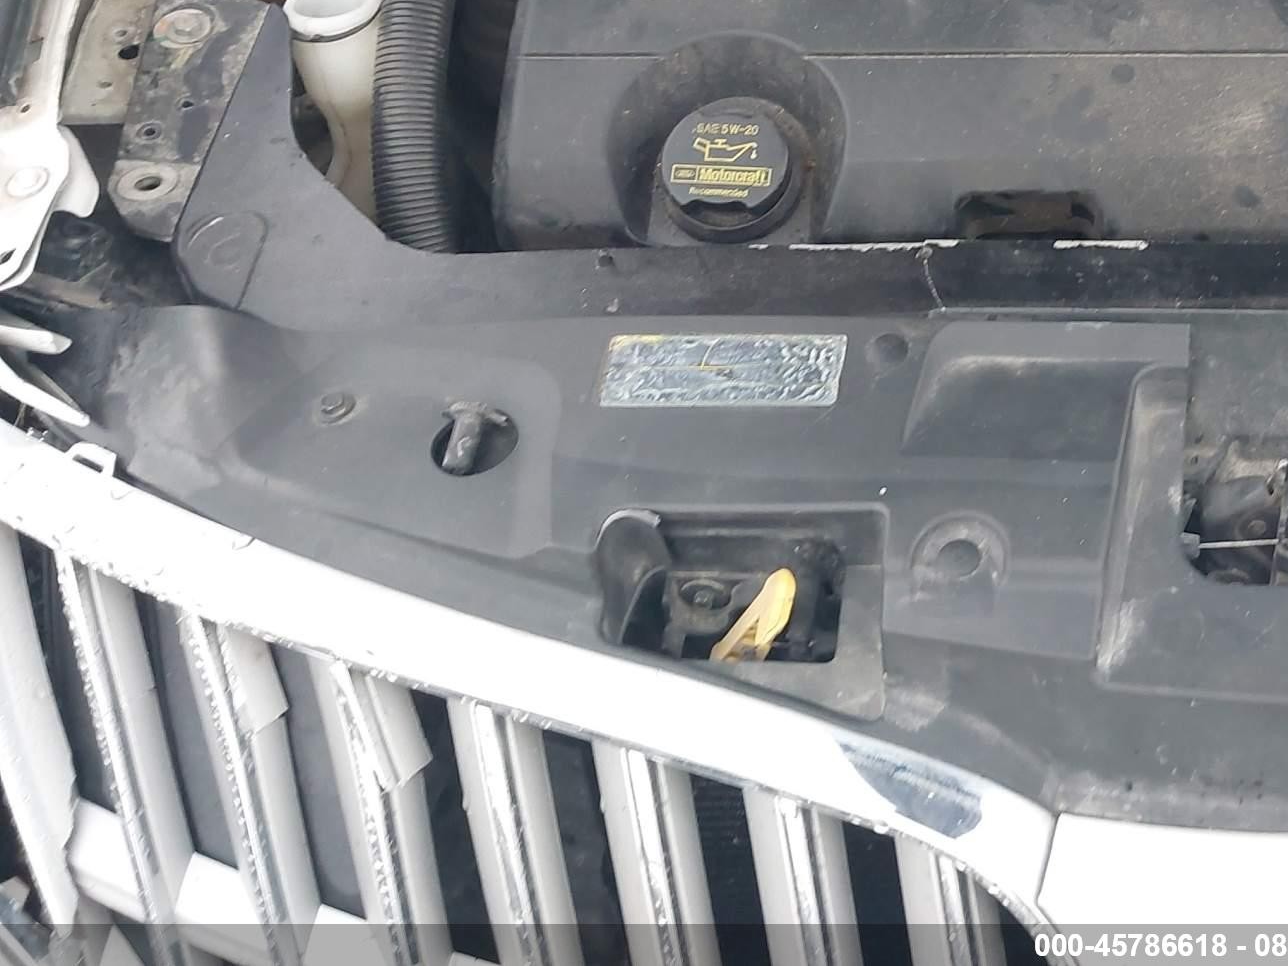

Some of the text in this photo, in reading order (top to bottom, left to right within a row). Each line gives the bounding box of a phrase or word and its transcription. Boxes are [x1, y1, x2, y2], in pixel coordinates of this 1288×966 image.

[696, 122, 760, 136] SAE 5W-20
[699, 168, 766, 184] Motorcraft
